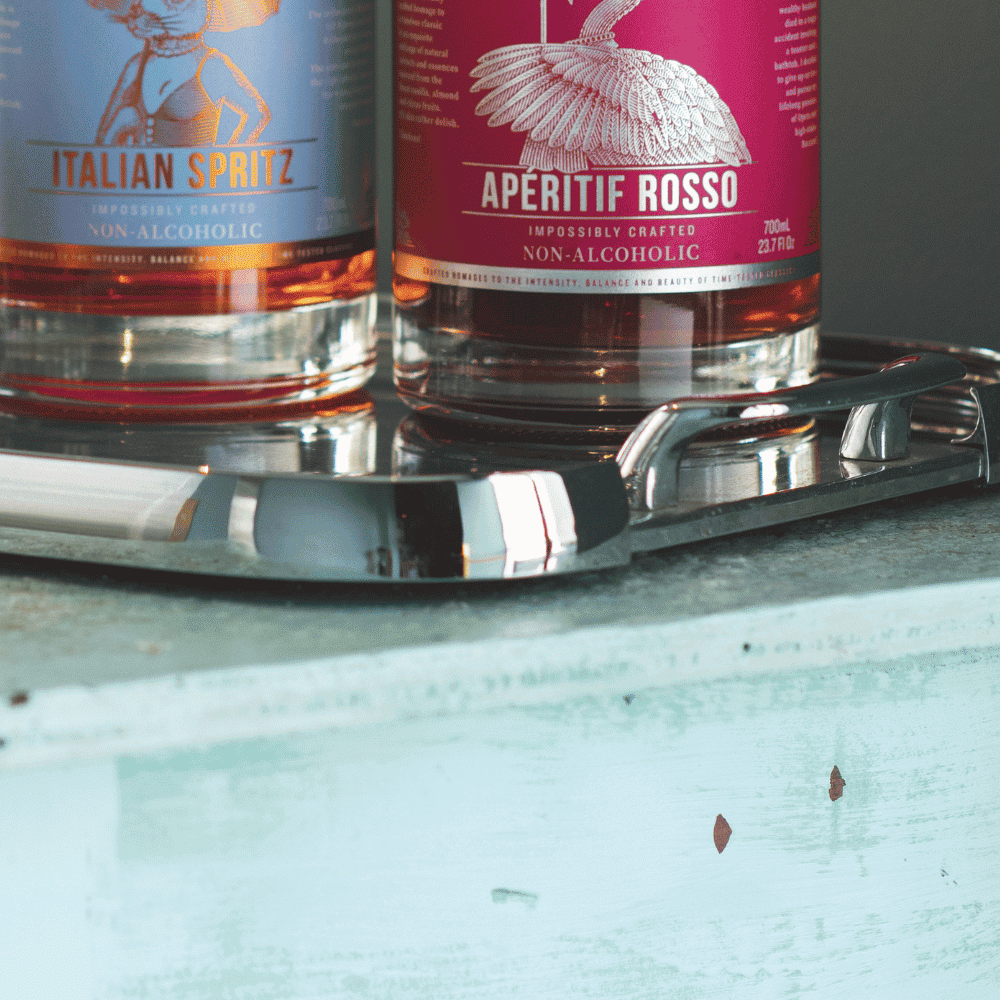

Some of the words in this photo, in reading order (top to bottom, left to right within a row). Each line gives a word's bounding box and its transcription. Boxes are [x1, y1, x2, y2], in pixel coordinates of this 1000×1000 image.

[52, 150, 174, 189] ITALIAN
[187, 148, 294, 190] SPRITZ
[481, 166, 626, 212] APÉRITIF
[638, 170, 738, 212] ROSSO
[92, 203, 183, 216] IMPOSSIBLY
[190, 202, 256, 216] CRAFTED
[88, 222, 263, 240] NON-ALCOHOLIC
[528, 225, 621, 238] IMPOSSIBLY
[628, 224, 696, 238] CRAFTED
[764, 217, 791, 235] 700mL
[523, 244, 700, 263] NON-ALCOHOLIC
[758, 236, 777, 254] 23.7
[150, 254, 194, 265] BALANCE
[452, 271, 488, 283] HOMAGES
[491, 274, 501, 284] TO
[505, 276, 522, 286] THE
[526, 277, 581, 288] INTENSITY,
[585, 278, 629, 288] BALANCE
[634, 278, 653, 287] AND
[657, 277, 694, 287] BEAUTY
[697, 275, 709, 285] OF
